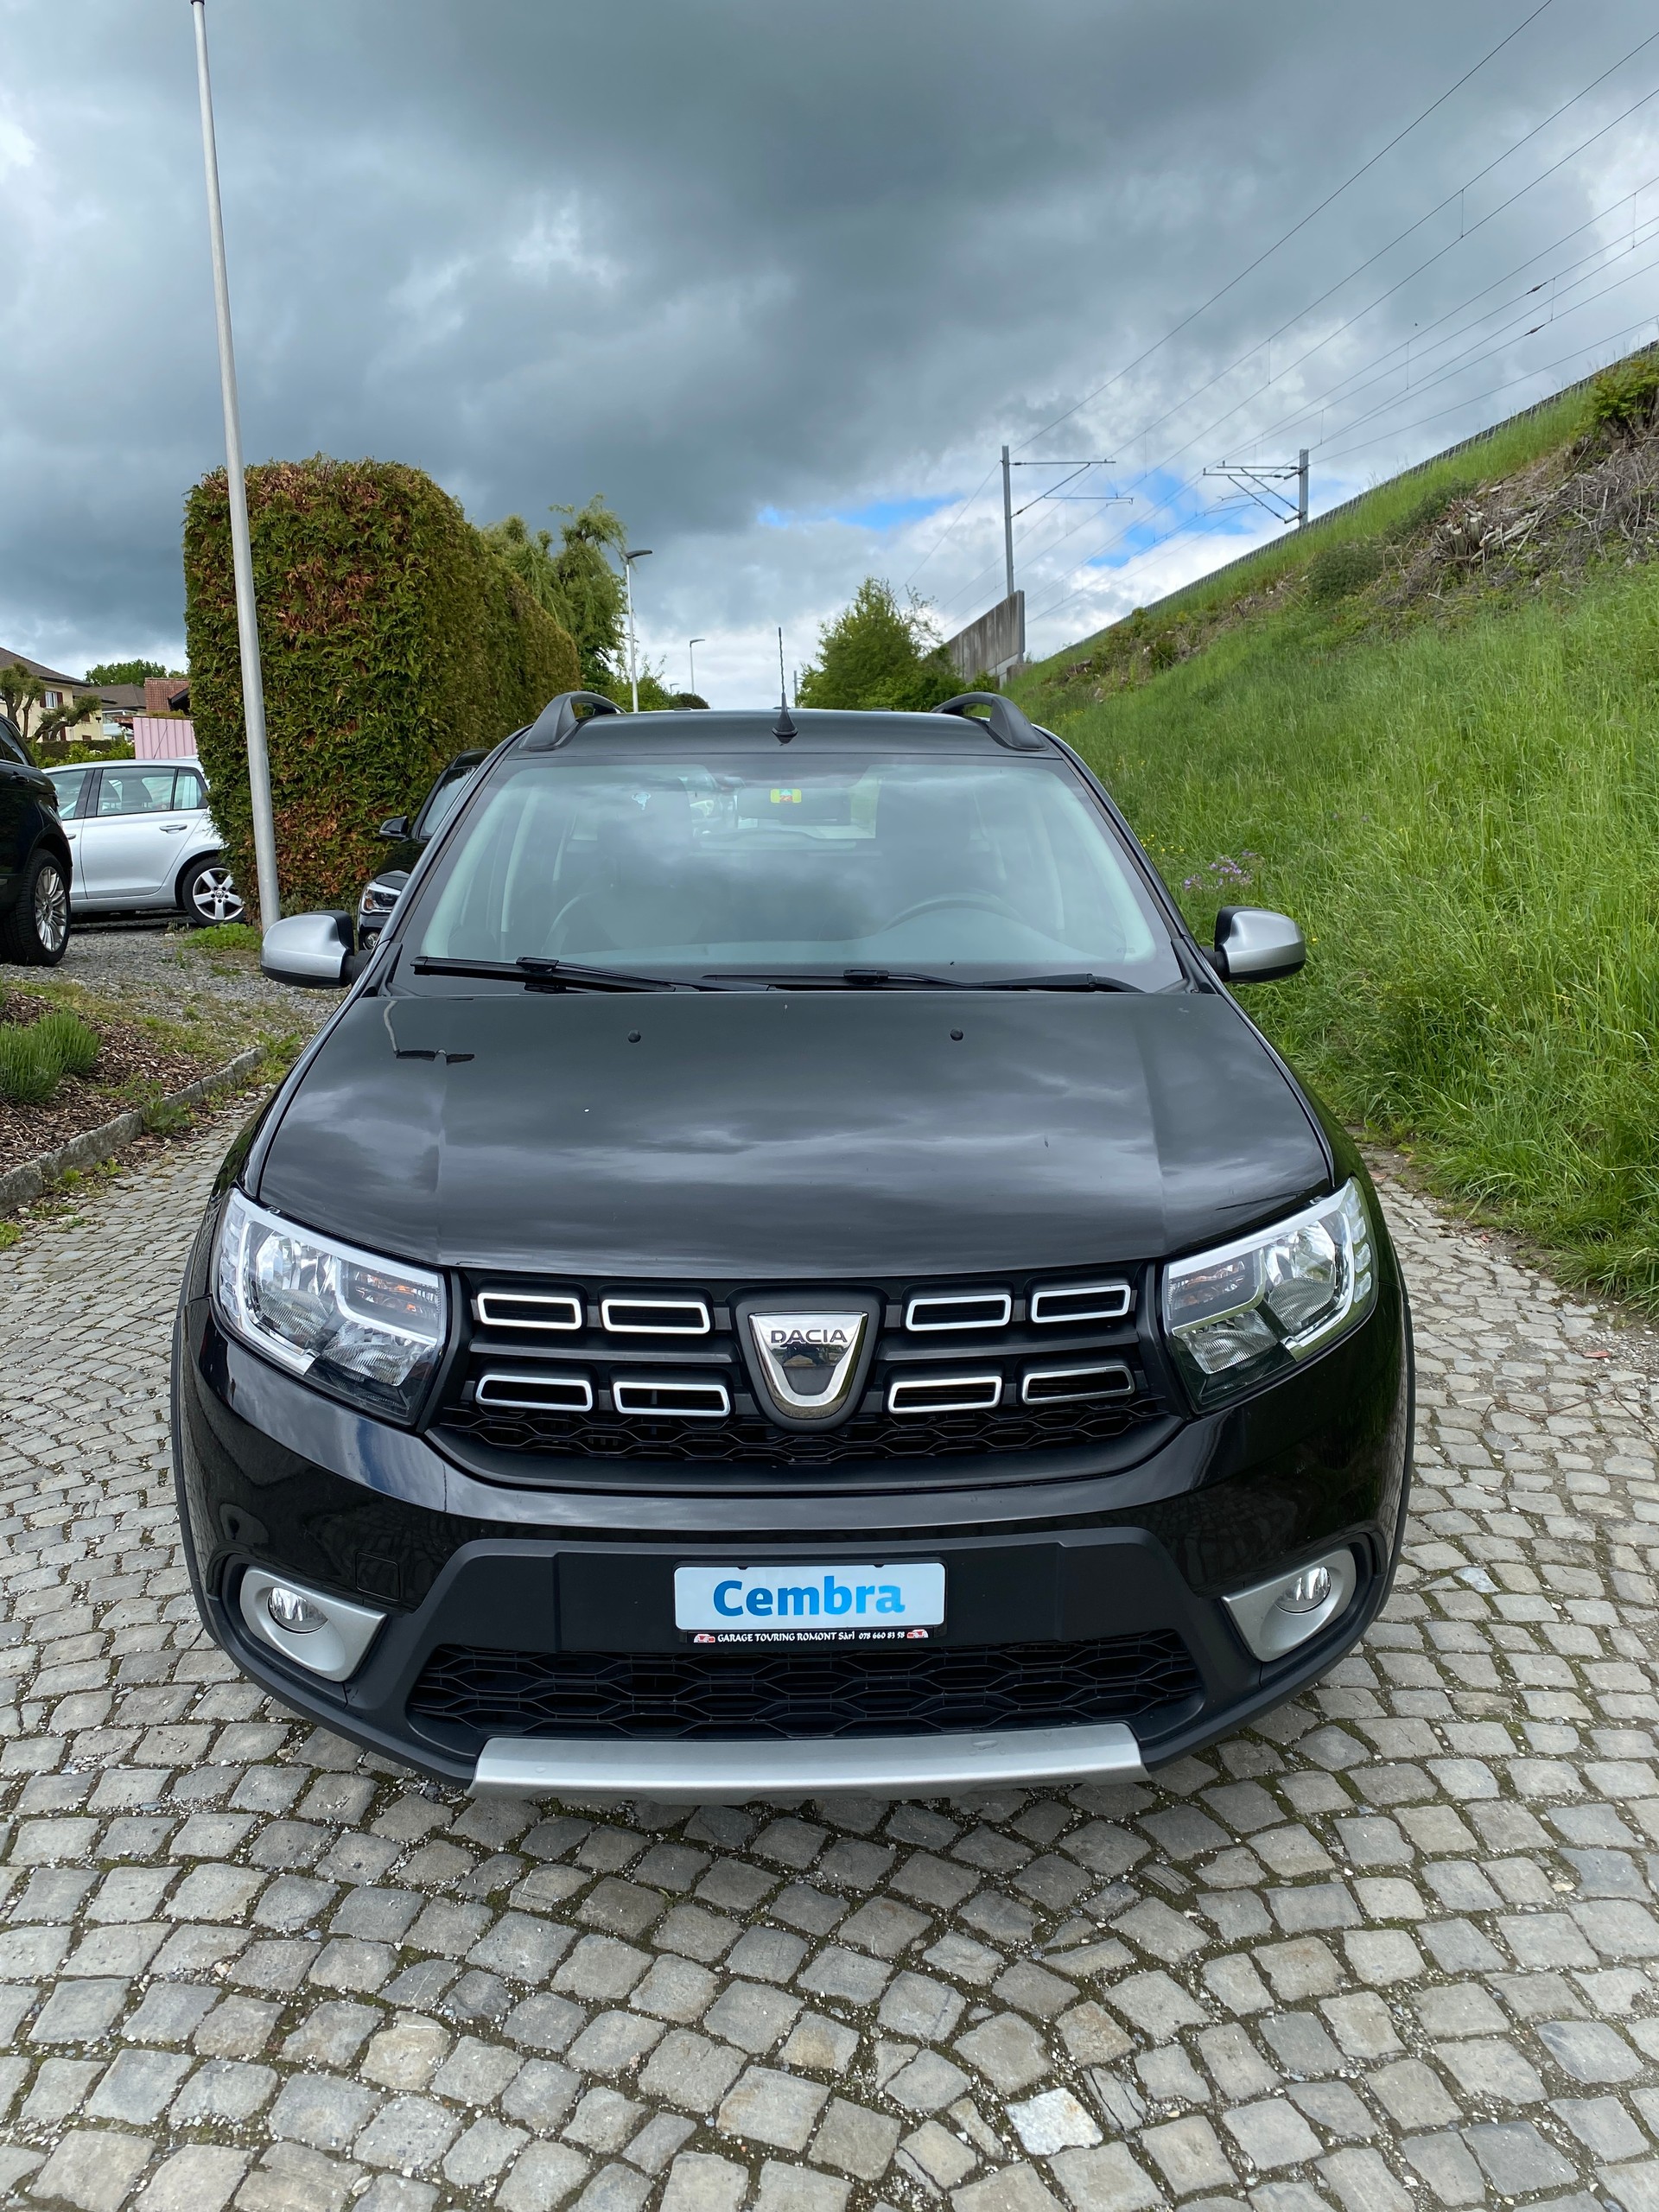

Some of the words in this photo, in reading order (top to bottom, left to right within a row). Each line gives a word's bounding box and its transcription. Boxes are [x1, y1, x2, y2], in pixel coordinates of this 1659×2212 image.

[771, 1329, 848, 1344] DACIA
[713, 1575, 906, 1617] Cembra
[717, 1633, 753, 1643] GARAGE
[754, 1632, 795, 1642] TOURING
[796, 1631, 837, 1641] ROMONT
[858, 1631, 871, 1640] 078
[897, 1630, 906, 1639] 58
